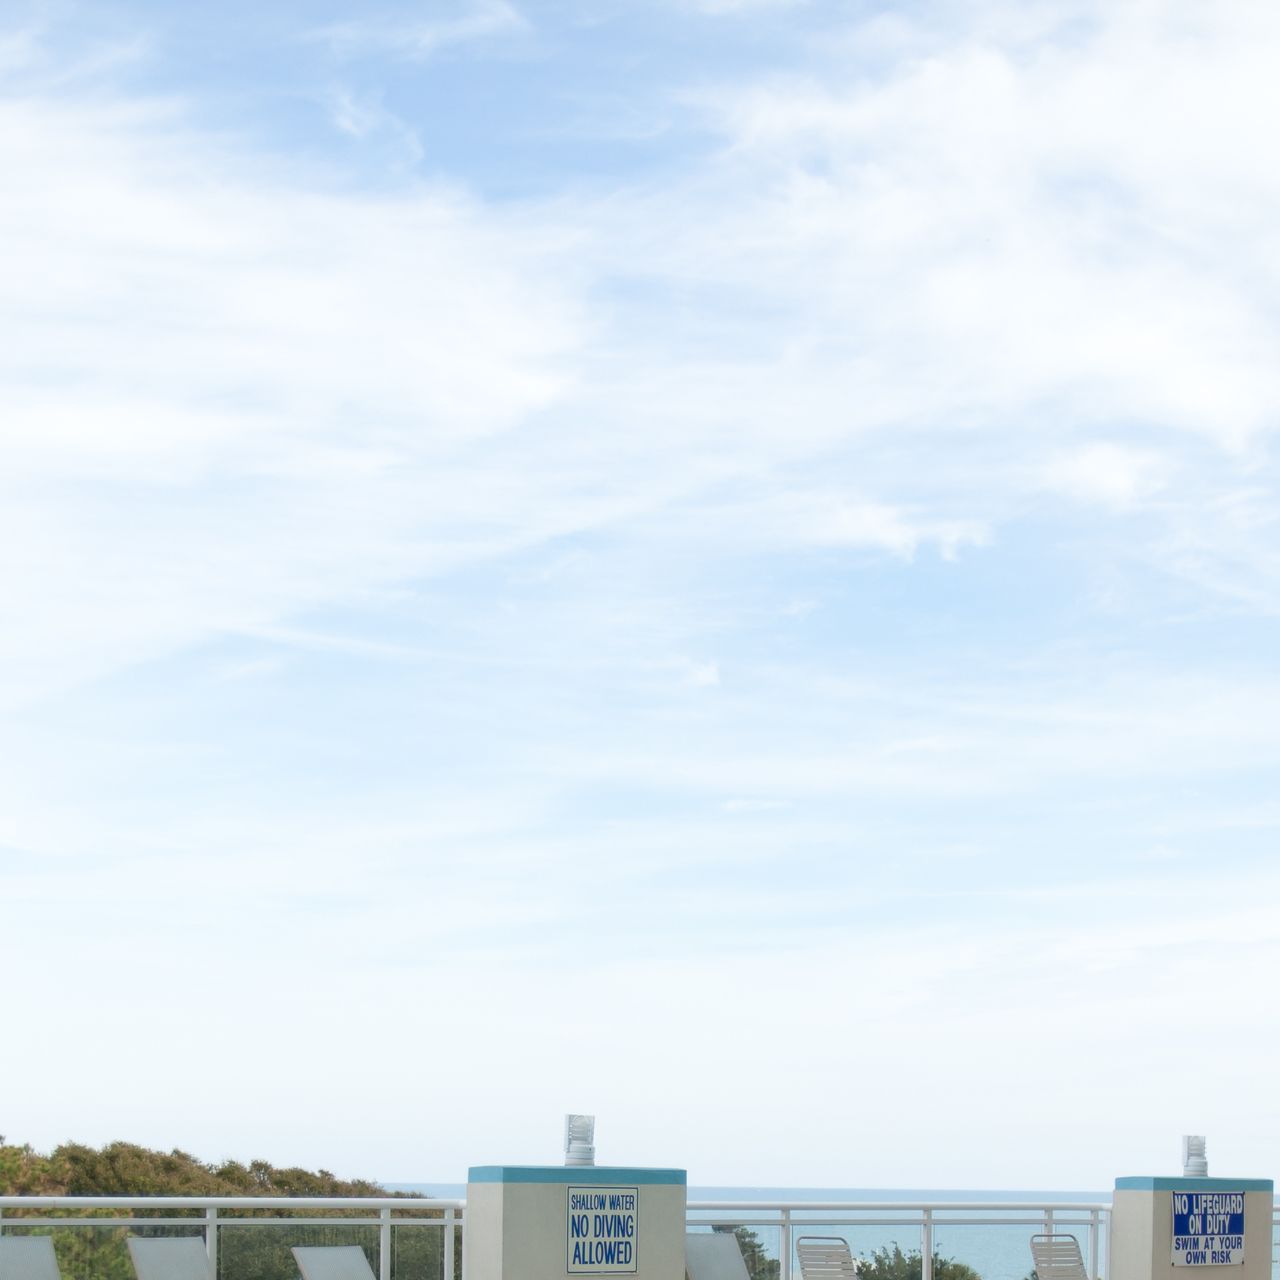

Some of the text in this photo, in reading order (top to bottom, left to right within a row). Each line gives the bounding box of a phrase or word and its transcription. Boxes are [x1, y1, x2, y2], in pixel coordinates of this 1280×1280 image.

[571, 1194, 634, 1210] SHALLOW WATER
[1174, 1195, 1243, 1215] NO LIFEGUARD
[571, 1214, 633, 1238] NO DIVING
[1189, 1215, 1230, 1234] ON DUTY
[573, 1241, 632, 1264] ALLOWED
[1175, 1236, 1242, 1250] SWIM AT YOUR
[1186, 1251, 1231, 1264] OWN RISK
